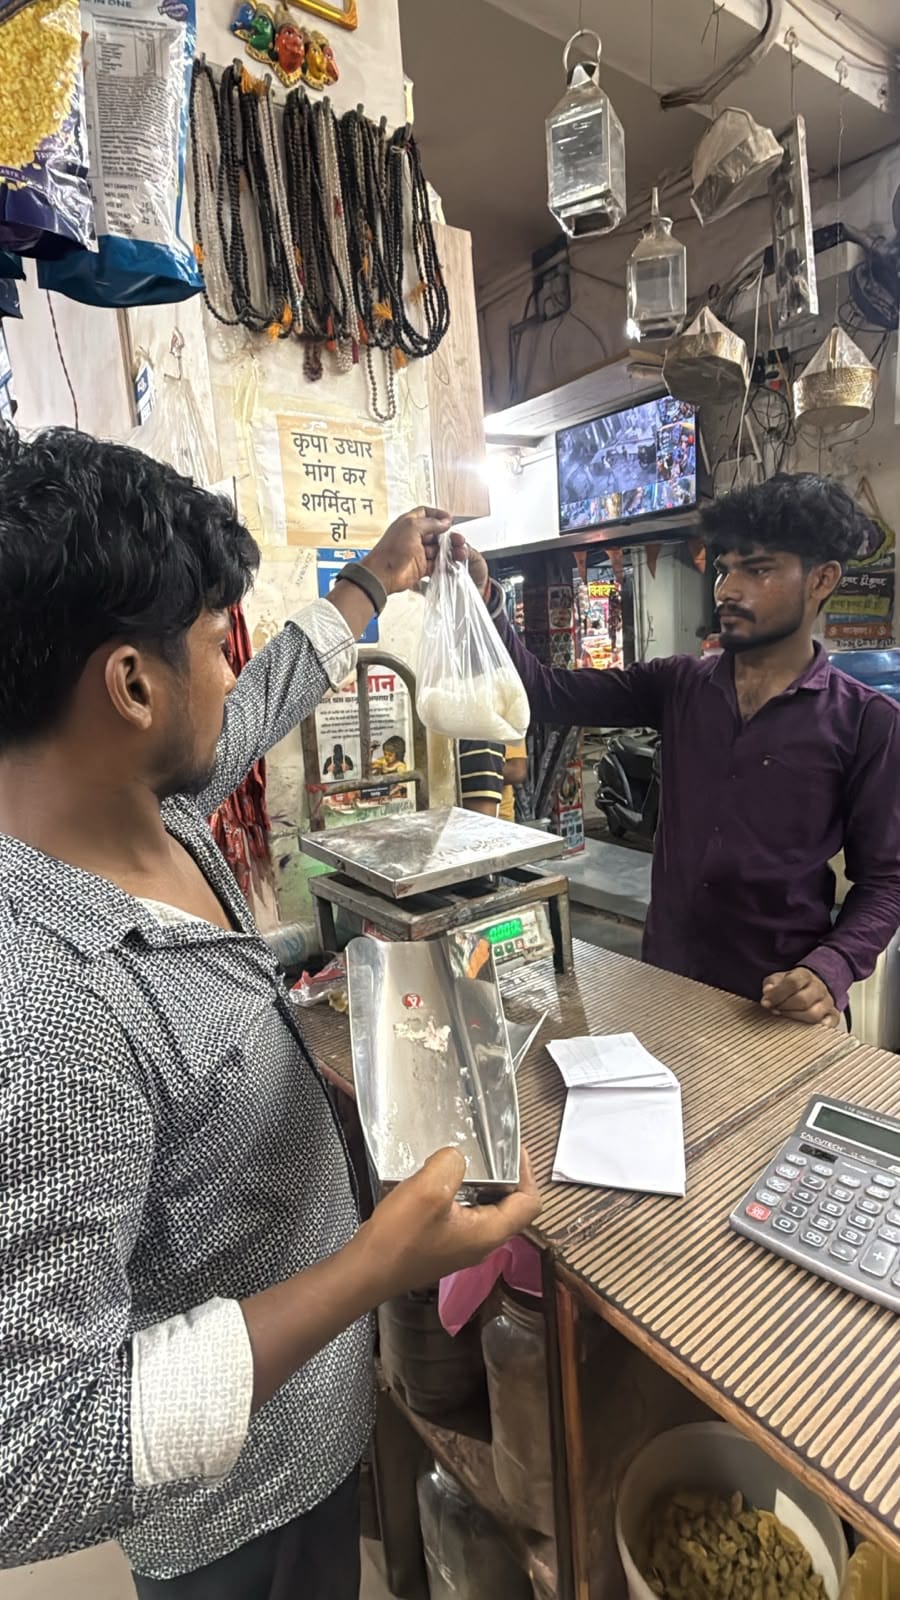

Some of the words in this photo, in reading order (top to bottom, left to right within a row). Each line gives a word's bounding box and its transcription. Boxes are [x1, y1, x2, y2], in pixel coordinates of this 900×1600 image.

[291, 432, 328, 457] कृपा
[333, 437, 373, 459] उधार
[302, 459, 336, 483] मांग
[341, 467, 367, 486] कर
[360, 498, 374, 515] न
[330, 517, 348, 542] हो
[800, 1131, 844, 1152] CALCUTECH
